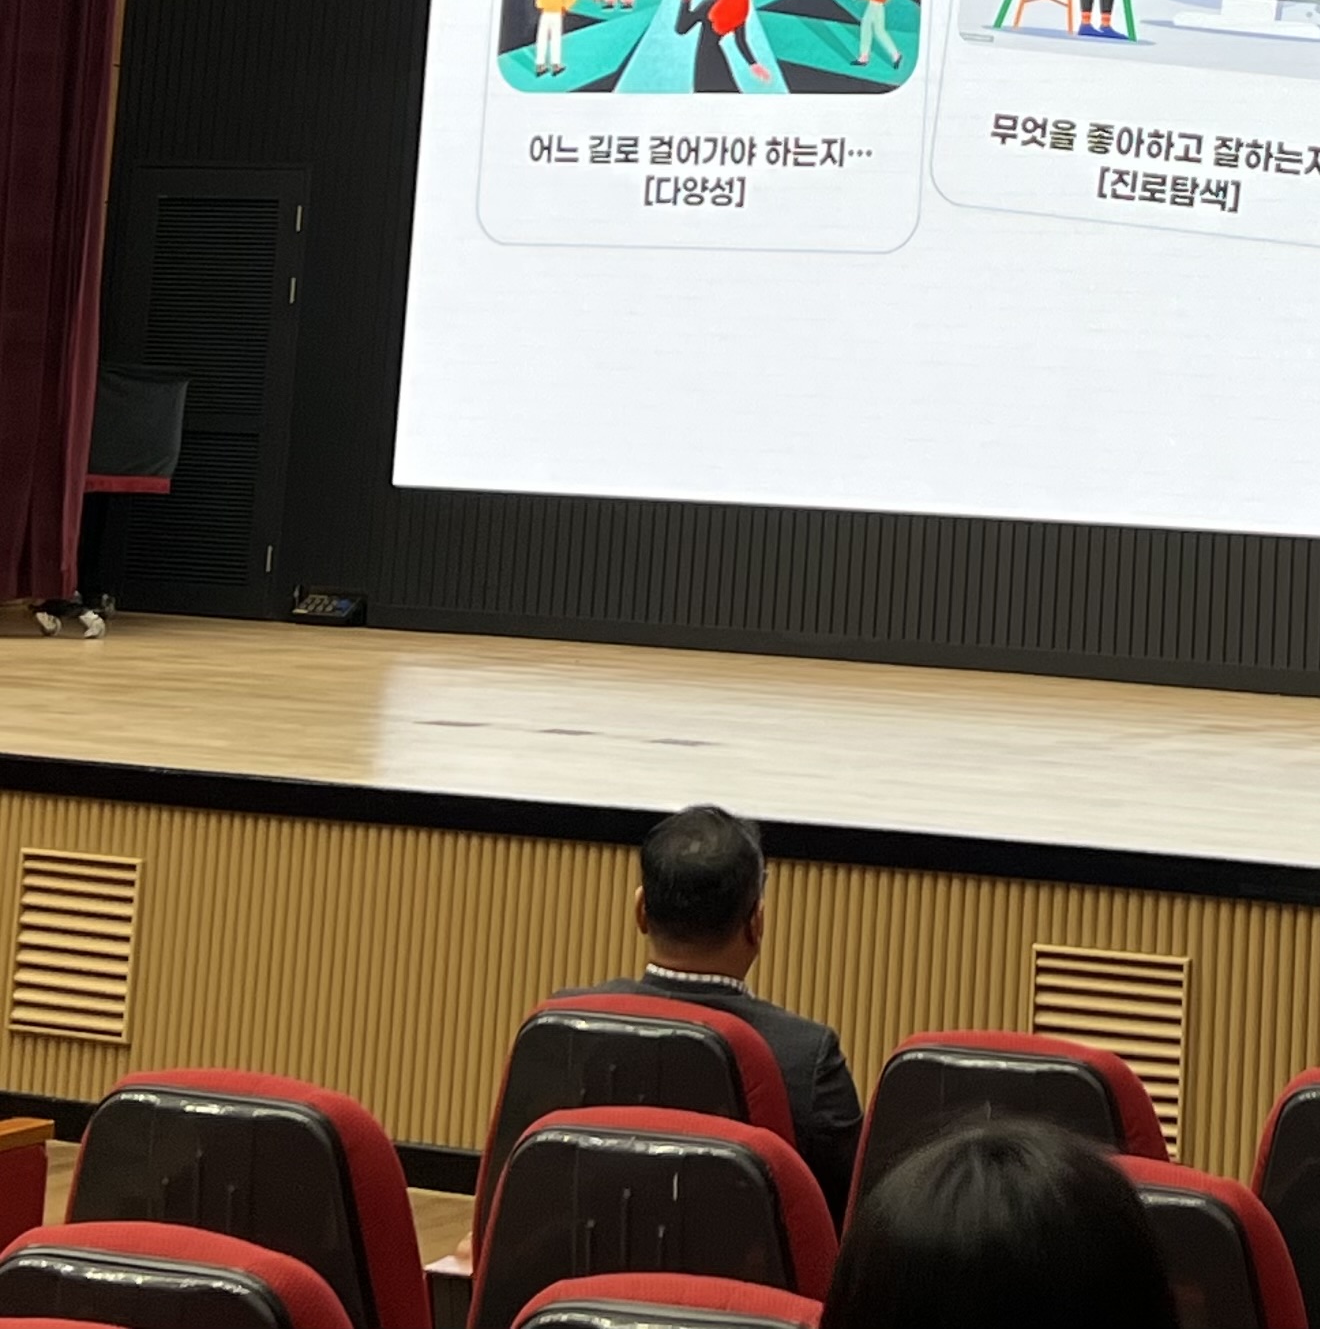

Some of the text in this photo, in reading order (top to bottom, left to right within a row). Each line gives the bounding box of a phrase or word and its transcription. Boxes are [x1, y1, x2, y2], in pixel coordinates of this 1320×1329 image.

[529, 134, 580, 164] 어느
[588, 134, 640, 165] 길로
[649, 135, 757, 167] 걸어가야
[990, 112, 1077, 152] 무엇을
[1086, 121, 1205, 164] 좋아하고
[643, 174, 747, 209] [다양성]
[1096, 165, 1243, 215] [진로탐색]
